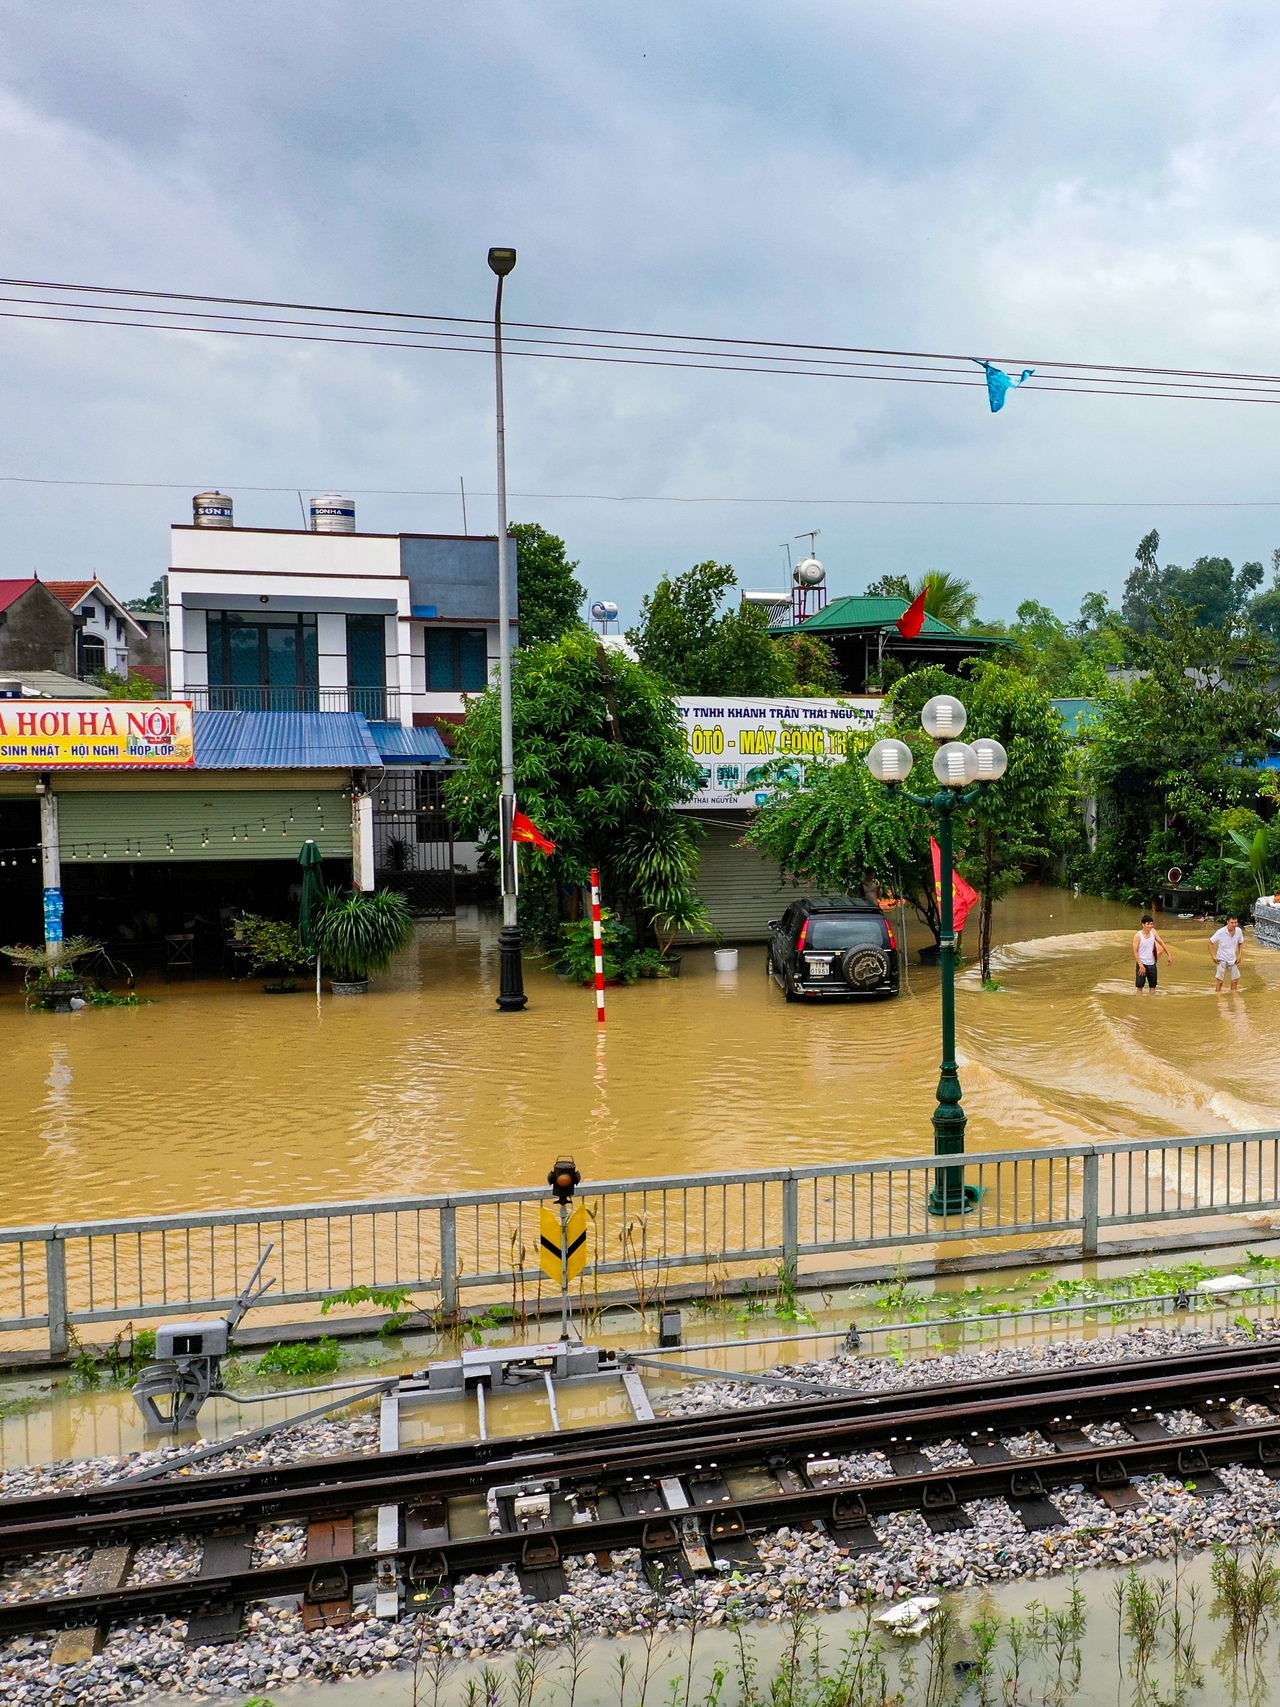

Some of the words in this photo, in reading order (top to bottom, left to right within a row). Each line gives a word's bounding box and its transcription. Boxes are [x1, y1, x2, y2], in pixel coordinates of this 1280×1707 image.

[693, 707, 724, 718] TNHH
[728, 706, 766, 719] KHÁNH
[802, 706, 827, 719] THÁI
[831, 707, 874, 719] NGUYÊN
[16, 711, 71, 736] HƠI
[77, 707, 118, 737] HÀ
[126, 706, 178, 740] NỘI
[692, 724, 724, 755] ÔTÔ
[739, 724, 777, 755] MÁY
[781, 727, 825, 755] CÔNG
[1, 745, 27, 757] SINH
[31, 743, 60, 758] NHẬT
[71, 743, 90, 758] HỘI
[93, 745, 119, 758] NGHỊ
[155, 743, 175, 757] LỚP
[694, 796, 709, 804] THÁI
[711, 796, 738, 804] NGUYÊN
